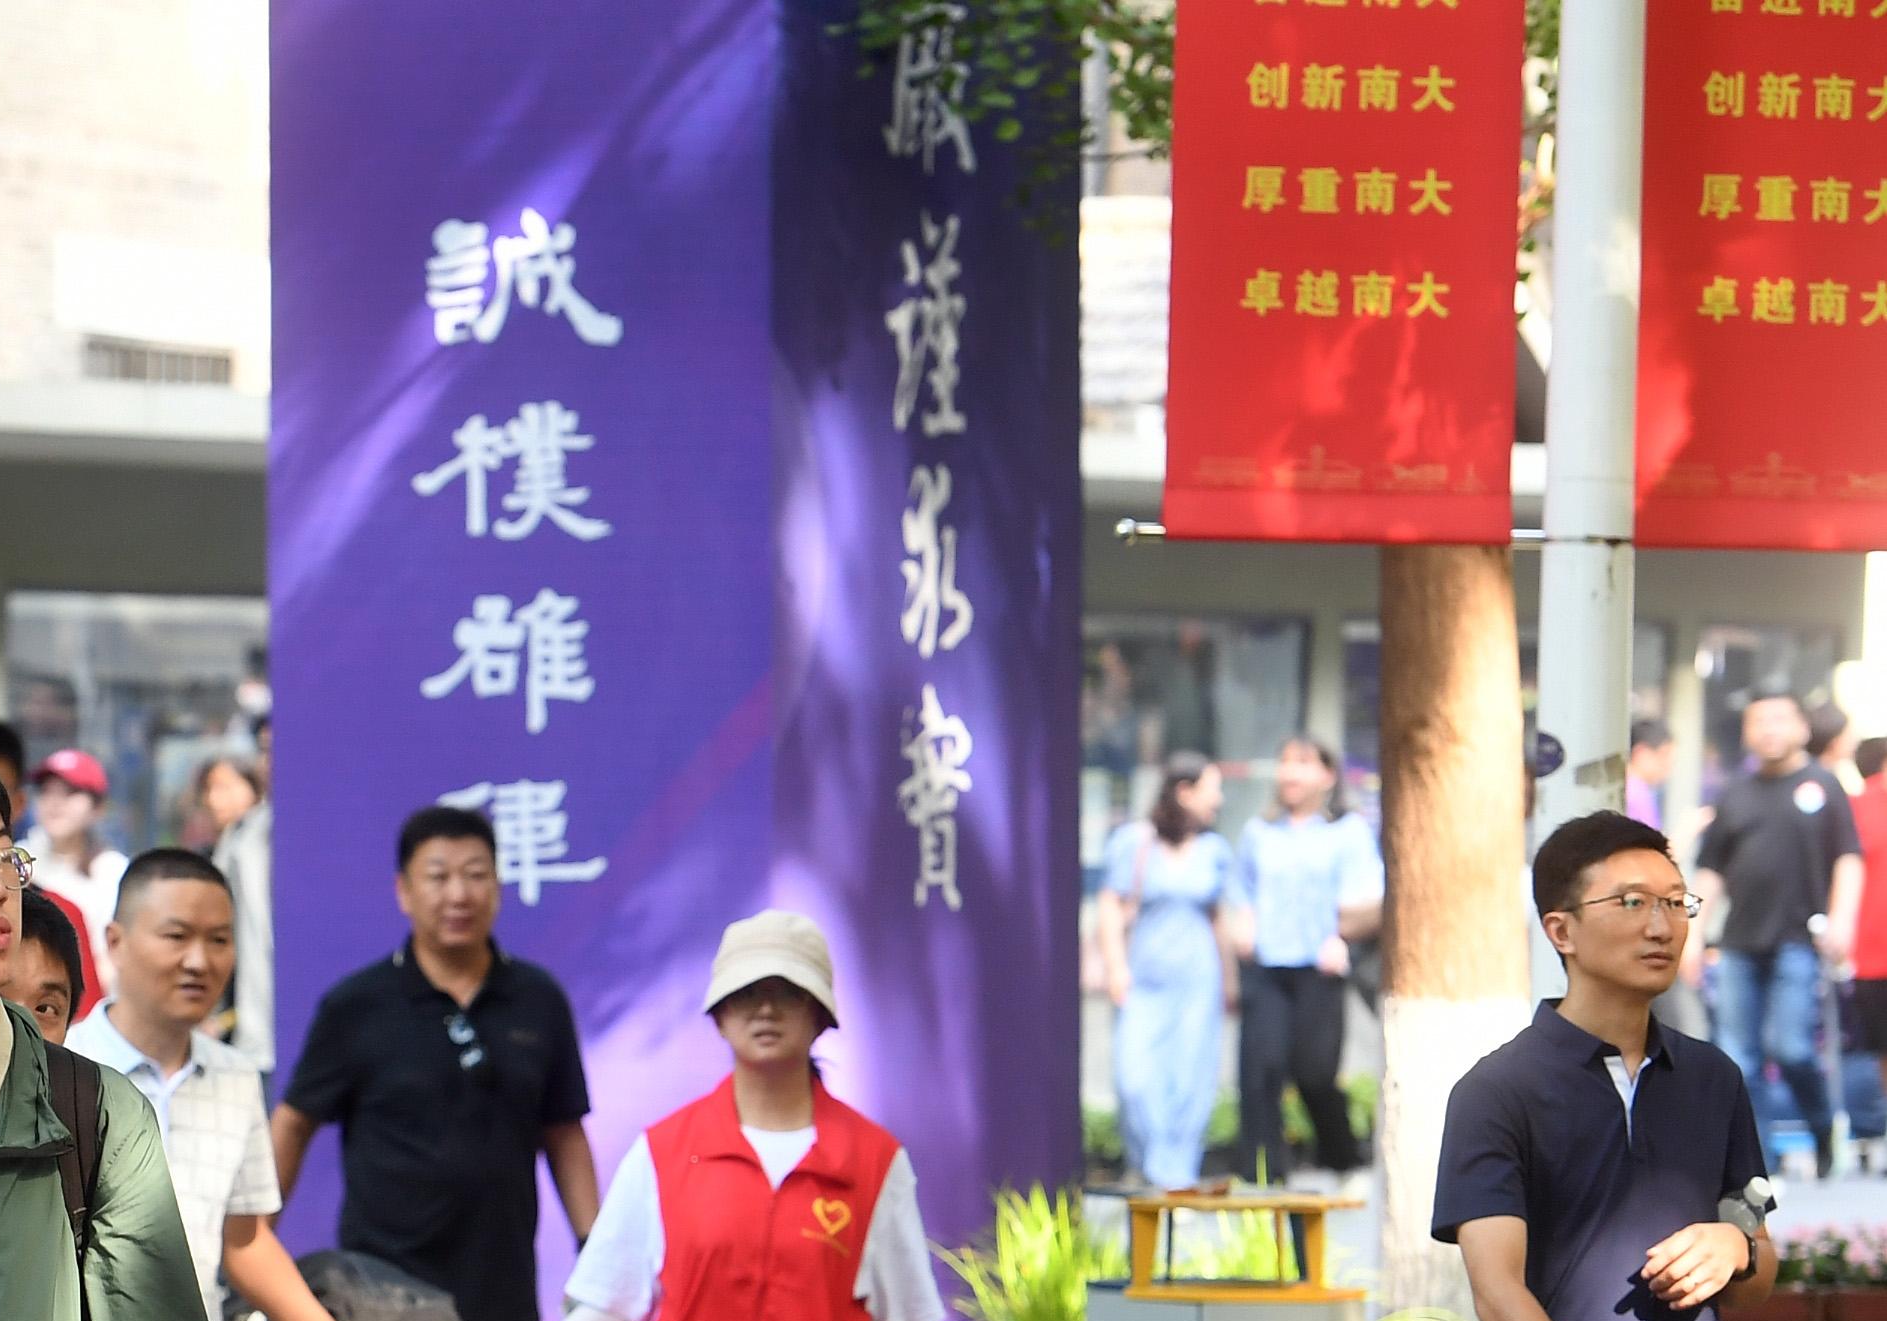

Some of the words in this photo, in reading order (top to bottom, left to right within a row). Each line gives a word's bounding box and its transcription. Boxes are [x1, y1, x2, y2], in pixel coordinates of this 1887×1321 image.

[1247, 62, 1456, 112] 创新南大
[1242, 165, 1453, 216] 厚重南大
[1241, 268, 1450, 318] 卓越南大
